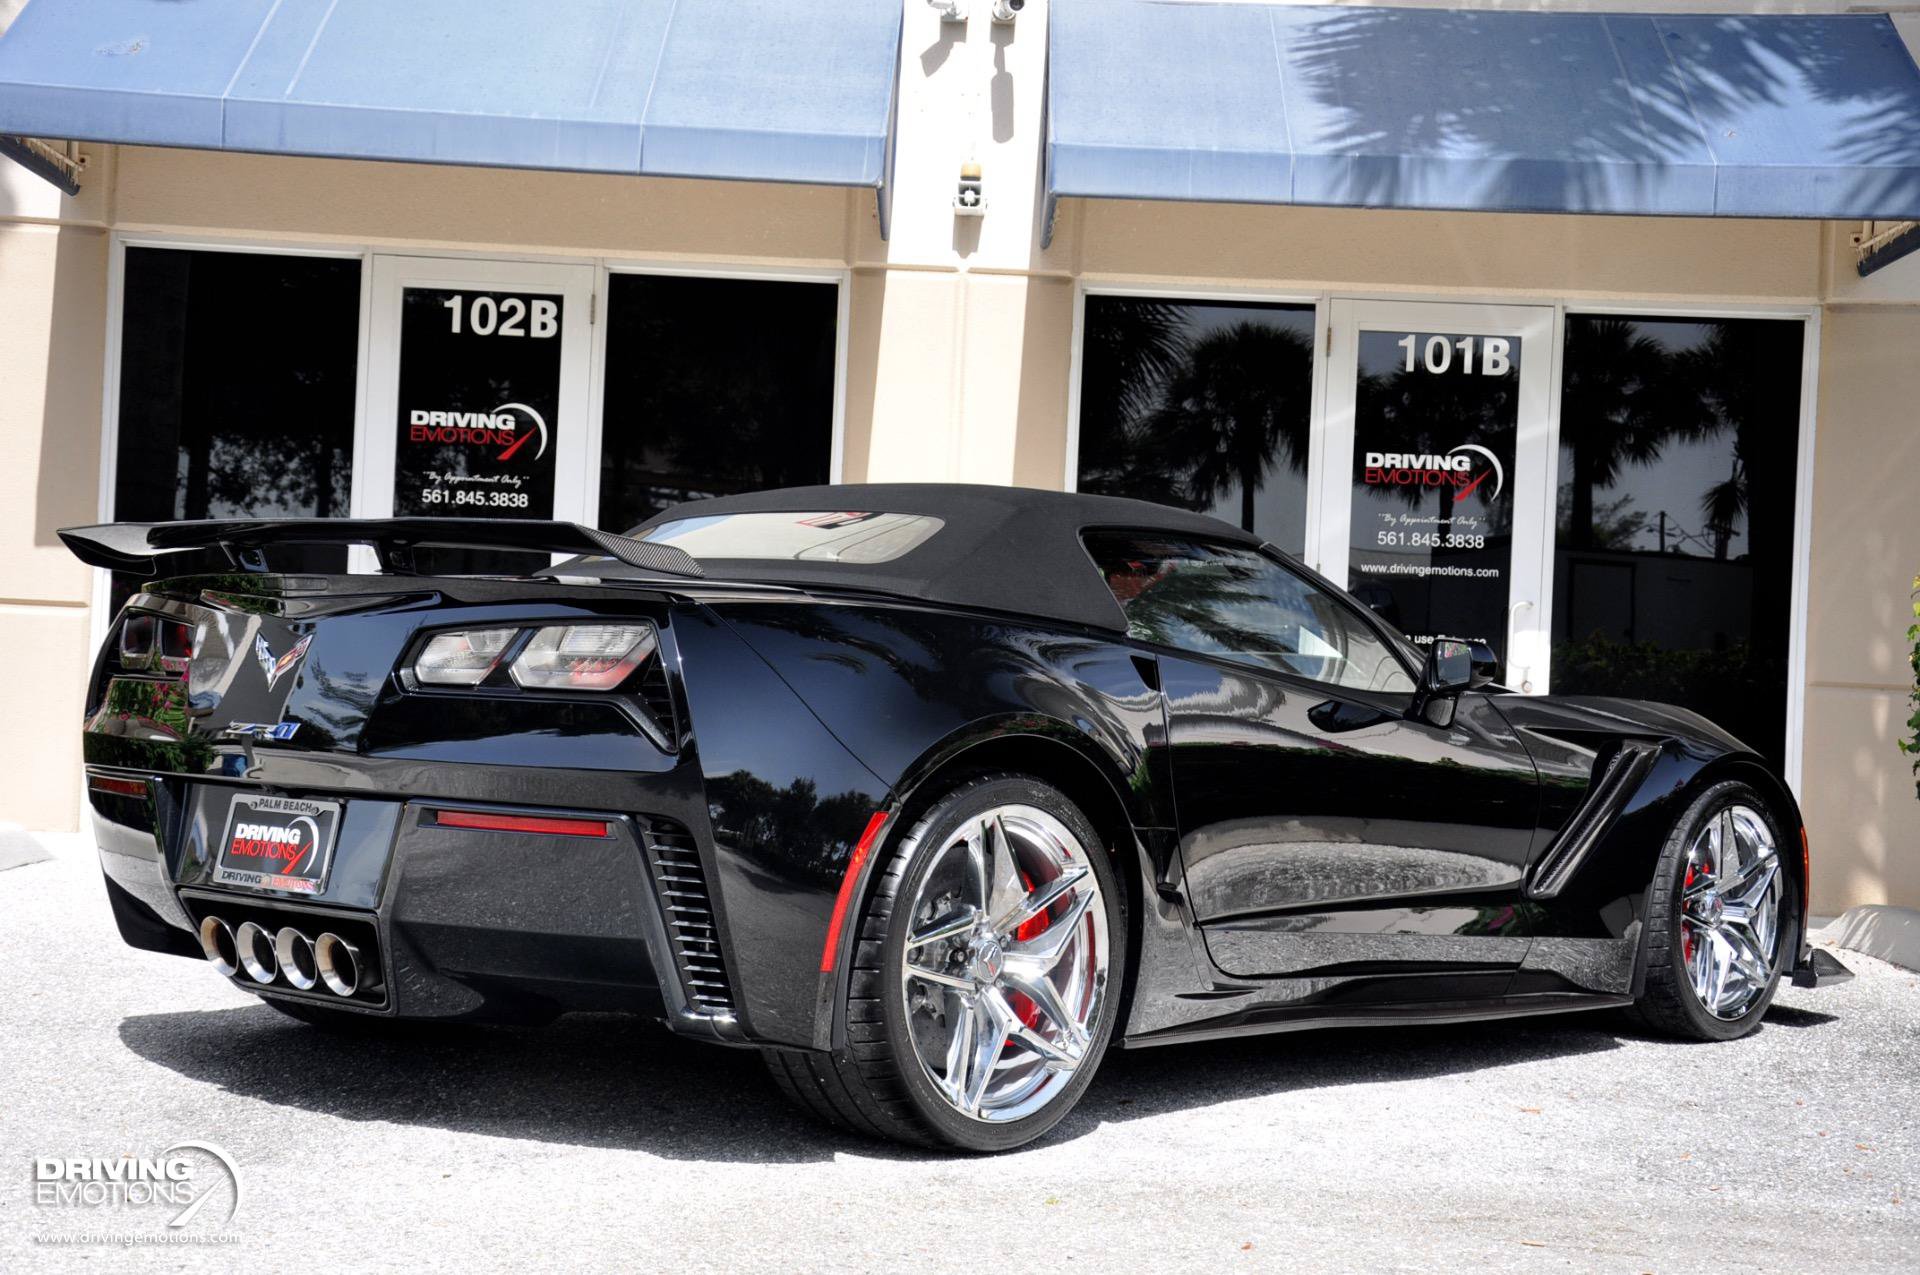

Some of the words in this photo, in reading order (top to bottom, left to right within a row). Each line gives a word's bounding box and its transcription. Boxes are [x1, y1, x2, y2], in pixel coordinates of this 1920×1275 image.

[444, 295, 558, 338] 102B
[1398, 334, 1510, 376] 101B
[410, 410, 516, 430] DRIVING
[410, 425, 515, 446] EMOTIONS
[1365, 452, 1471, 472] DRIVING
[1364, 468, 1471, 488] EMOTIONS
[421, 488, 529, 508] 561.845.3838
[1399, 513, 1456, 526] Appointment
[1377, 531, 1485, 549] 561.845.3838
[1360, 563, 1499, 577] www.drivingemotions.com
[1414, 635, 1434, 644] use
[258, 799, 281, 809] PALM
[282, 801, 312, 813] BEACH
[234, 823, 301, 845] DRIVING
[230, 839, 298, 861] EMOTIONS
[221, 870, 262, 884] DRIVING
